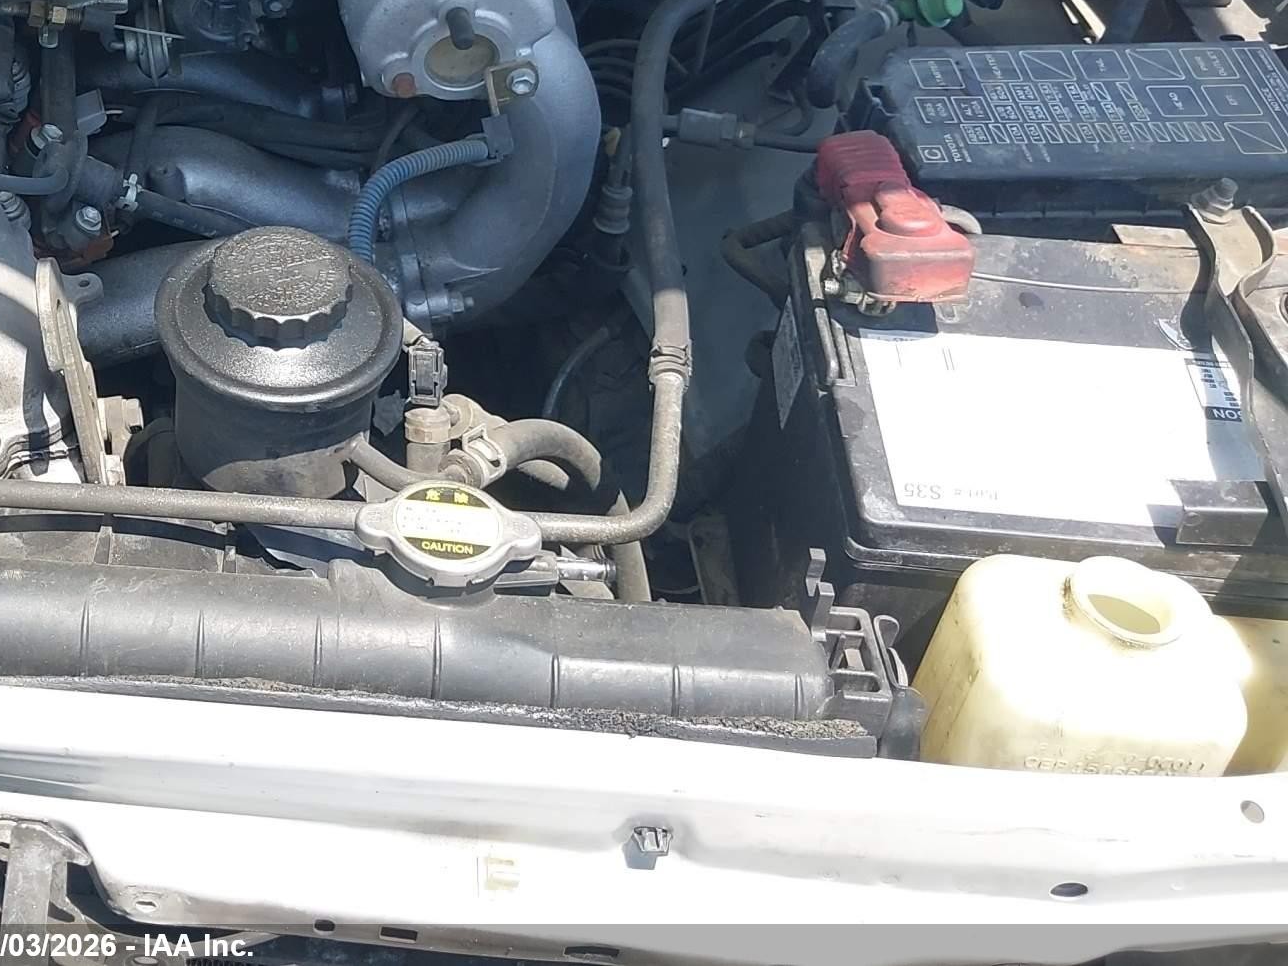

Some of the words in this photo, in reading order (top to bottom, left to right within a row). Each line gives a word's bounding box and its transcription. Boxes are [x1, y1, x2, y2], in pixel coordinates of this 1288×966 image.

[924, 148, 942, 160] C
[943, 133, 962, 163] TOYOTA
[903, 482, 943, 501] S35
[421, 540, 474, 555] CAUTION
